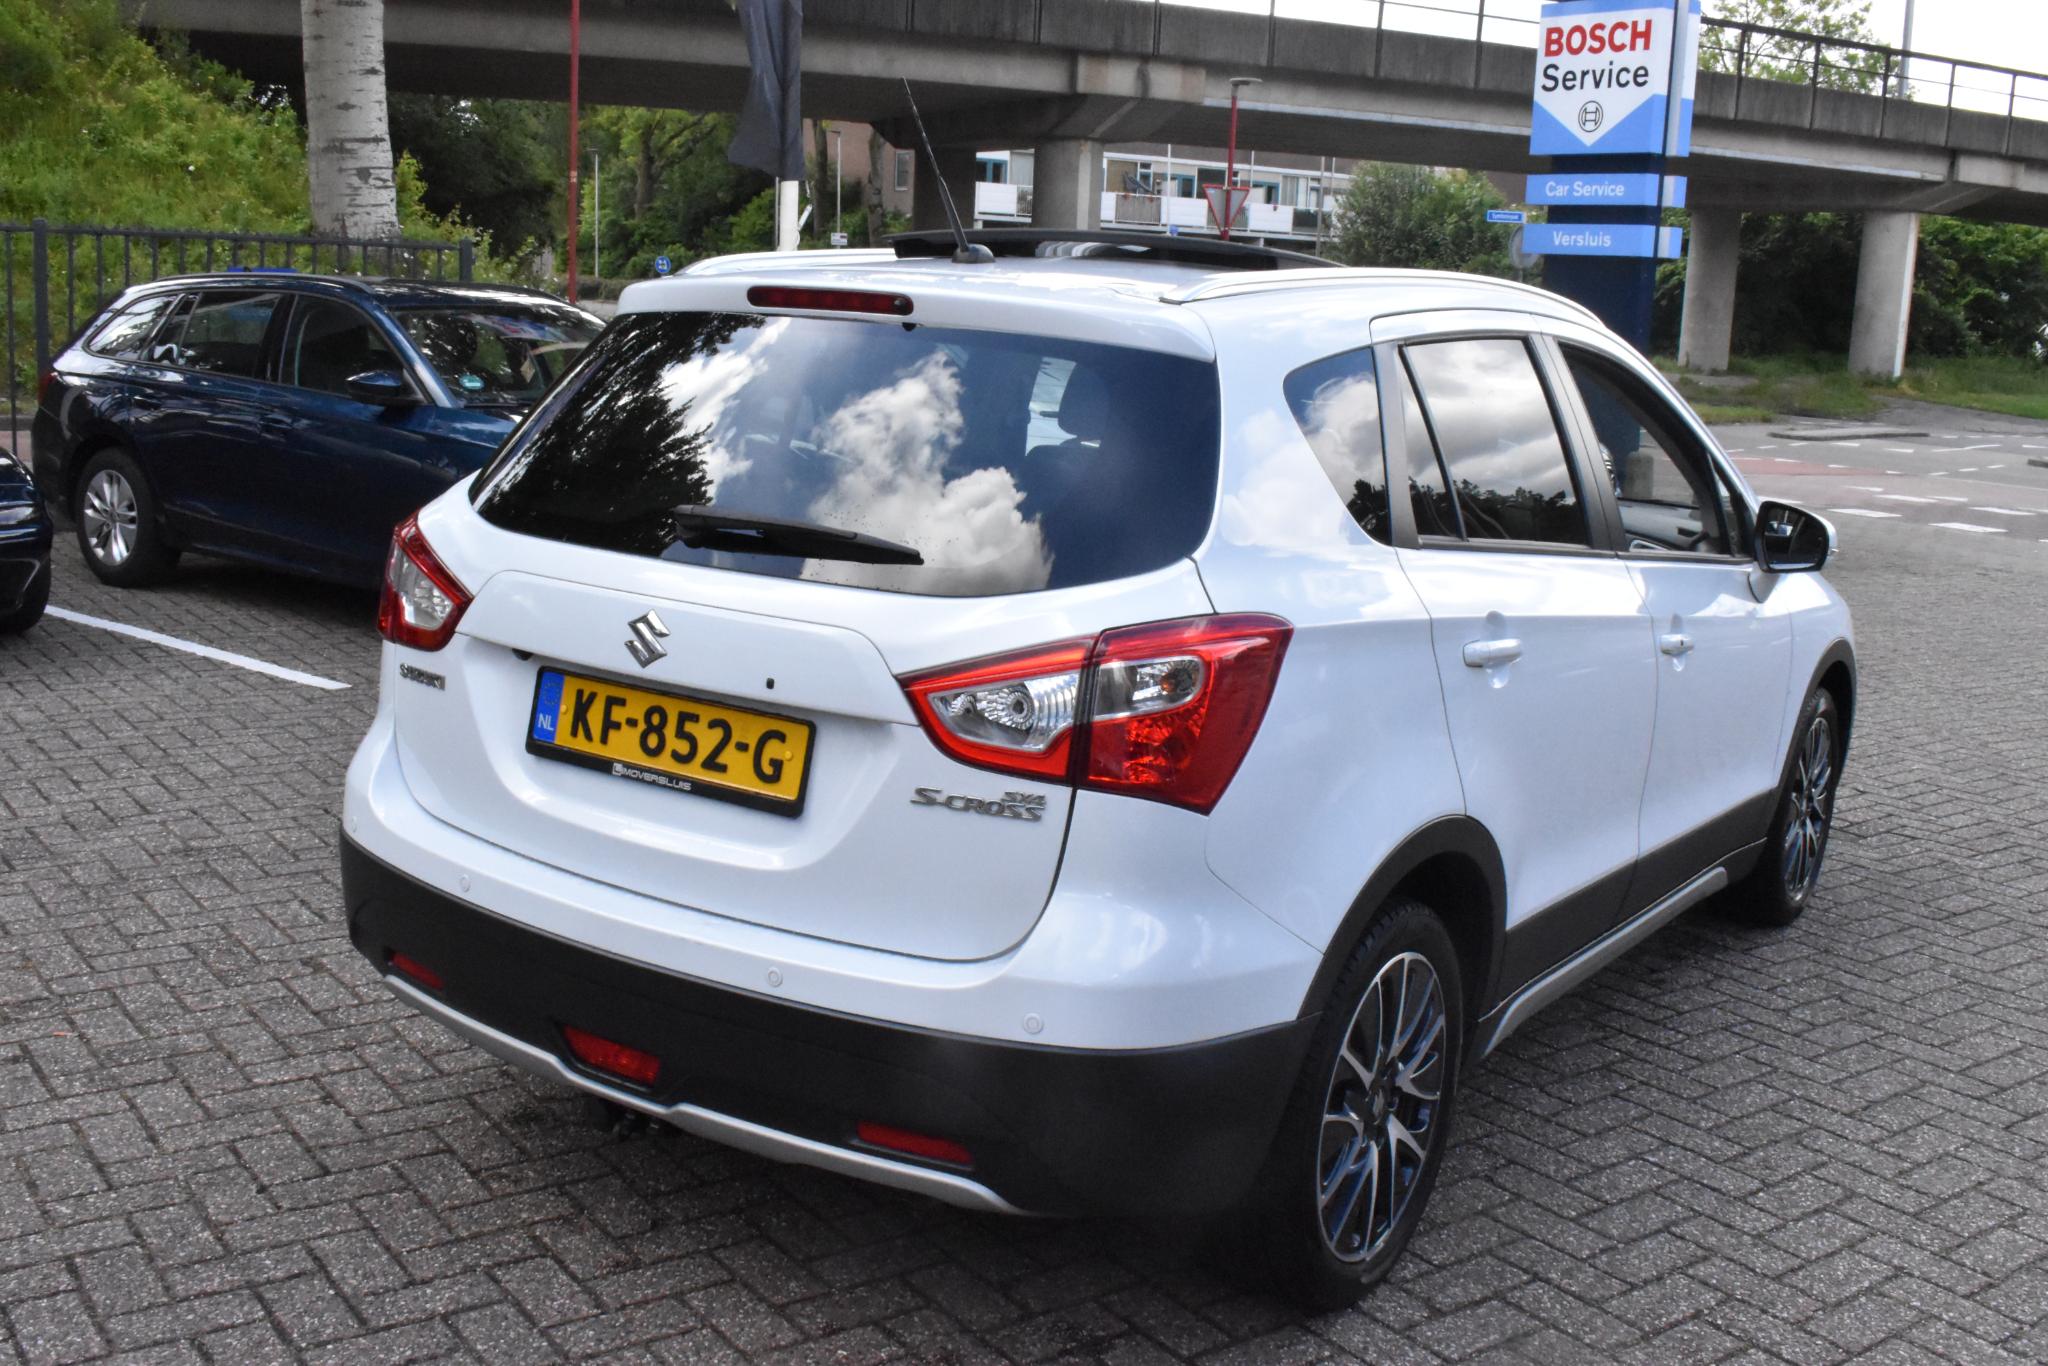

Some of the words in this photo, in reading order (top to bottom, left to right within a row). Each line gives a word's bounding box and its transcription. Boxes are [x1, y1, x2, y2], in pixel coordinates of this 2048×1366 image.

[1544, 19, 1652, 57] BOSCH
[1541, 60, 1649, 92] Service
[1545, 181, 1569, 196] Car
[1572, 181, 1625, 196] Service
[1553, 231, 1612, 247] Versluis
[538, 713, 554, 731] NL
[570, 688, 787, 784] KF-852-G
